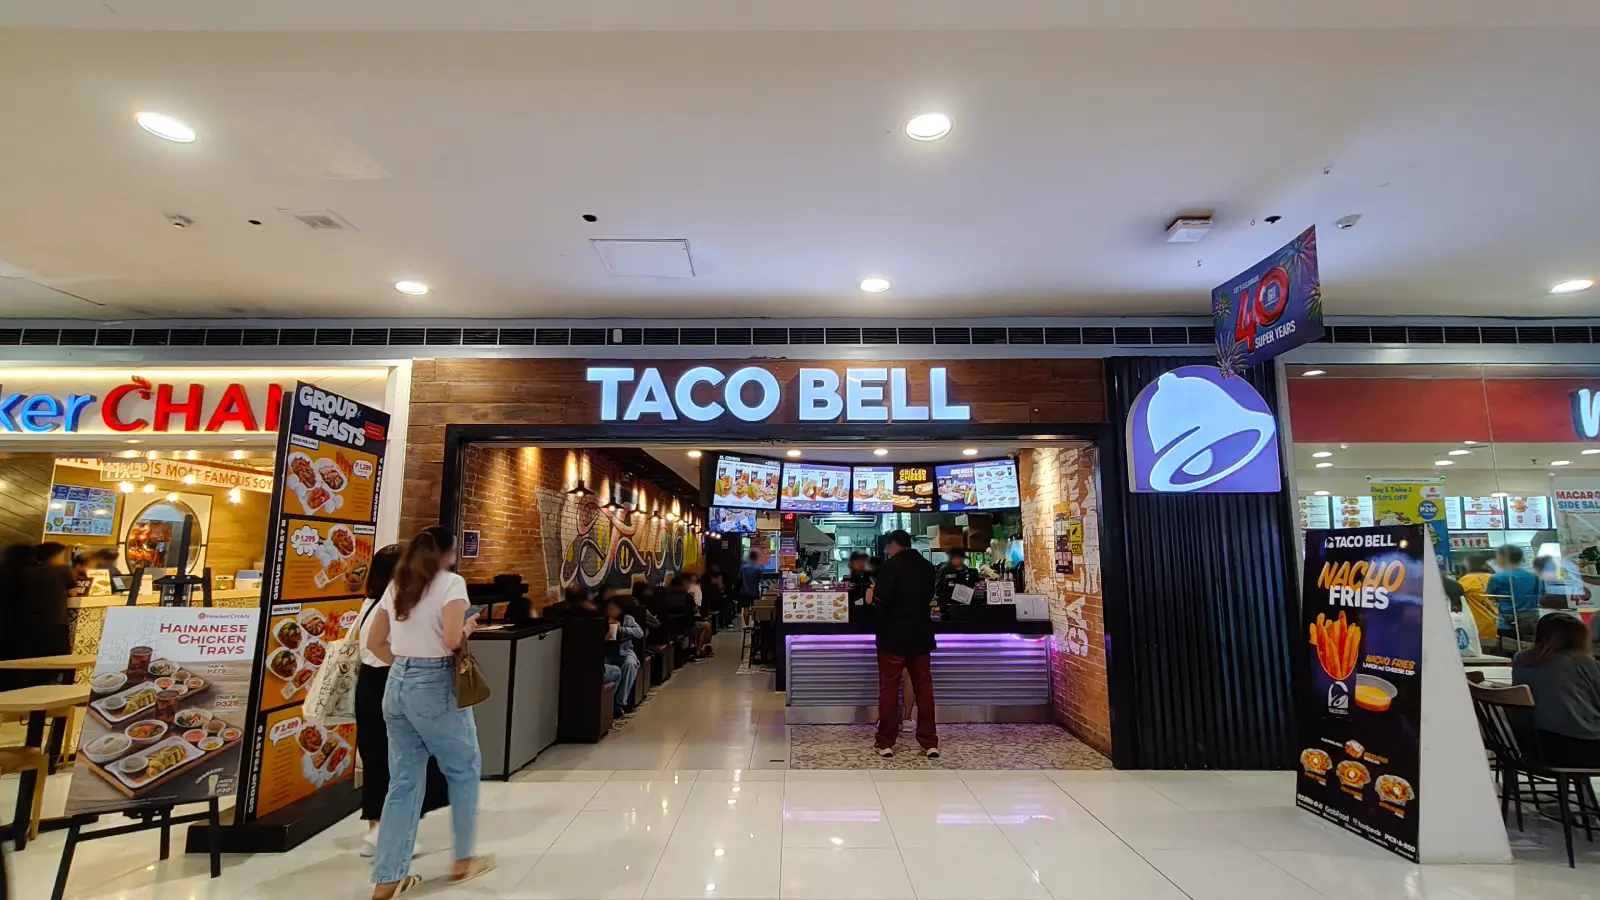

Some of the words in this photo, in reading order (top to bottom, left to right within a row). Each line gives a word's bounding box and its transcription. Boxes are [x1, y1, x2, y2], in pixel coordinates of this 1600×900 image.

[1235, 266, 1288, 353] 40
[1254, 331, 1274, 349] SUPER
[1274, 320, 1296, 340] YEARS
[300, 385, 358, 420] GROUP
[587, 366, 780, 422] TACO
[799, 367, 971, 421] BELL
[308, 410, 366, 446] FEASTS
[204, 470, 251, 487] FAMOUS
[253, 478, 273, 490] SOY
[899, 468, 927, 476] GRILLED
[1557, 501, 1580, 509] SIDE
[1334, 535, 1363, 548] TACO
[1365, 534, 1395, 547] BELL
[1317, 560, 1406, 592] NACHO
[1329, 585, 1389, 610] FRIES
[160, 623, 248, 633] HAINANESE
[178, 634, 246, 644] CHICKEN
[198, 645, 245, 655] TRAYS
[1365, 654, 1390, 666] NACHO
[1391, 659, 1416, 670] FRIES
[249, 774, 257, 814] GROUP
[254, 735, 262, 770] FEAST
[1324, 805, 1350, 822] GrabFood
